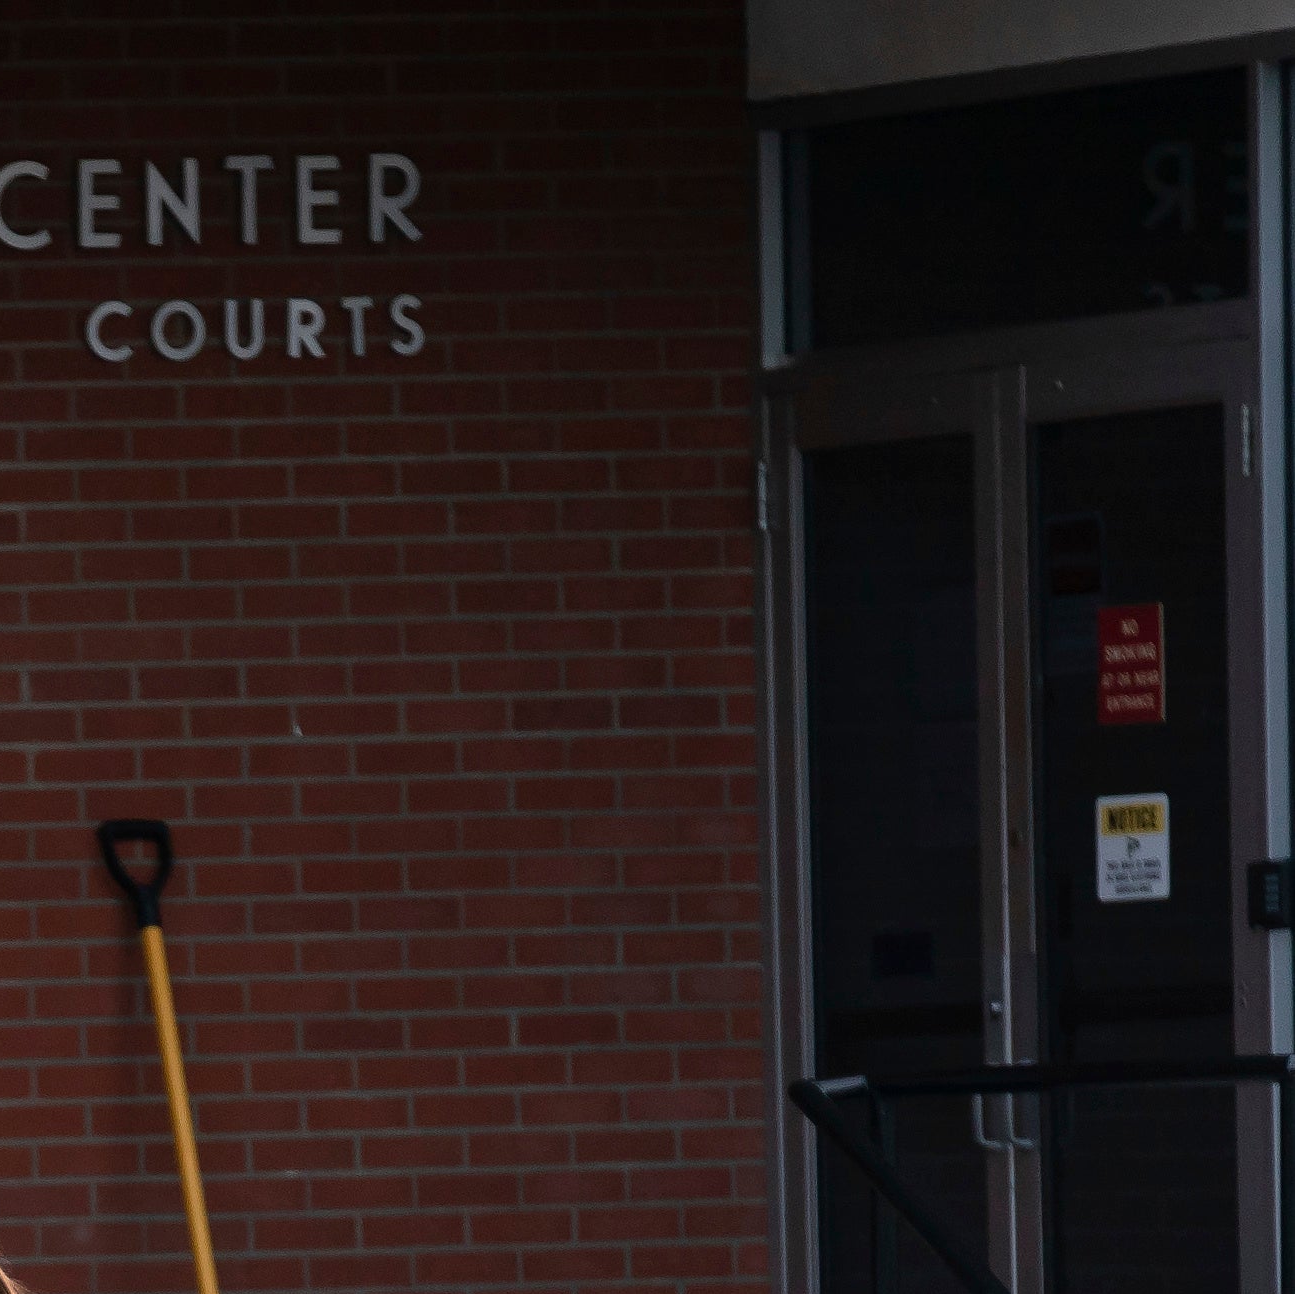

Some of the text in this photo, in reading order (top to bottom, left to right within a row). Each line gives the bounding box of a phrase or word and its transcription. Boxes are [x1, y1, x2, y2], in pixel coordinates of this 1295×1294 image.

[85, 294, 427, 363] COURTS
[1120, 618, 1140, 638] NO
[1108, 804, 1157, 830] NOTICE
